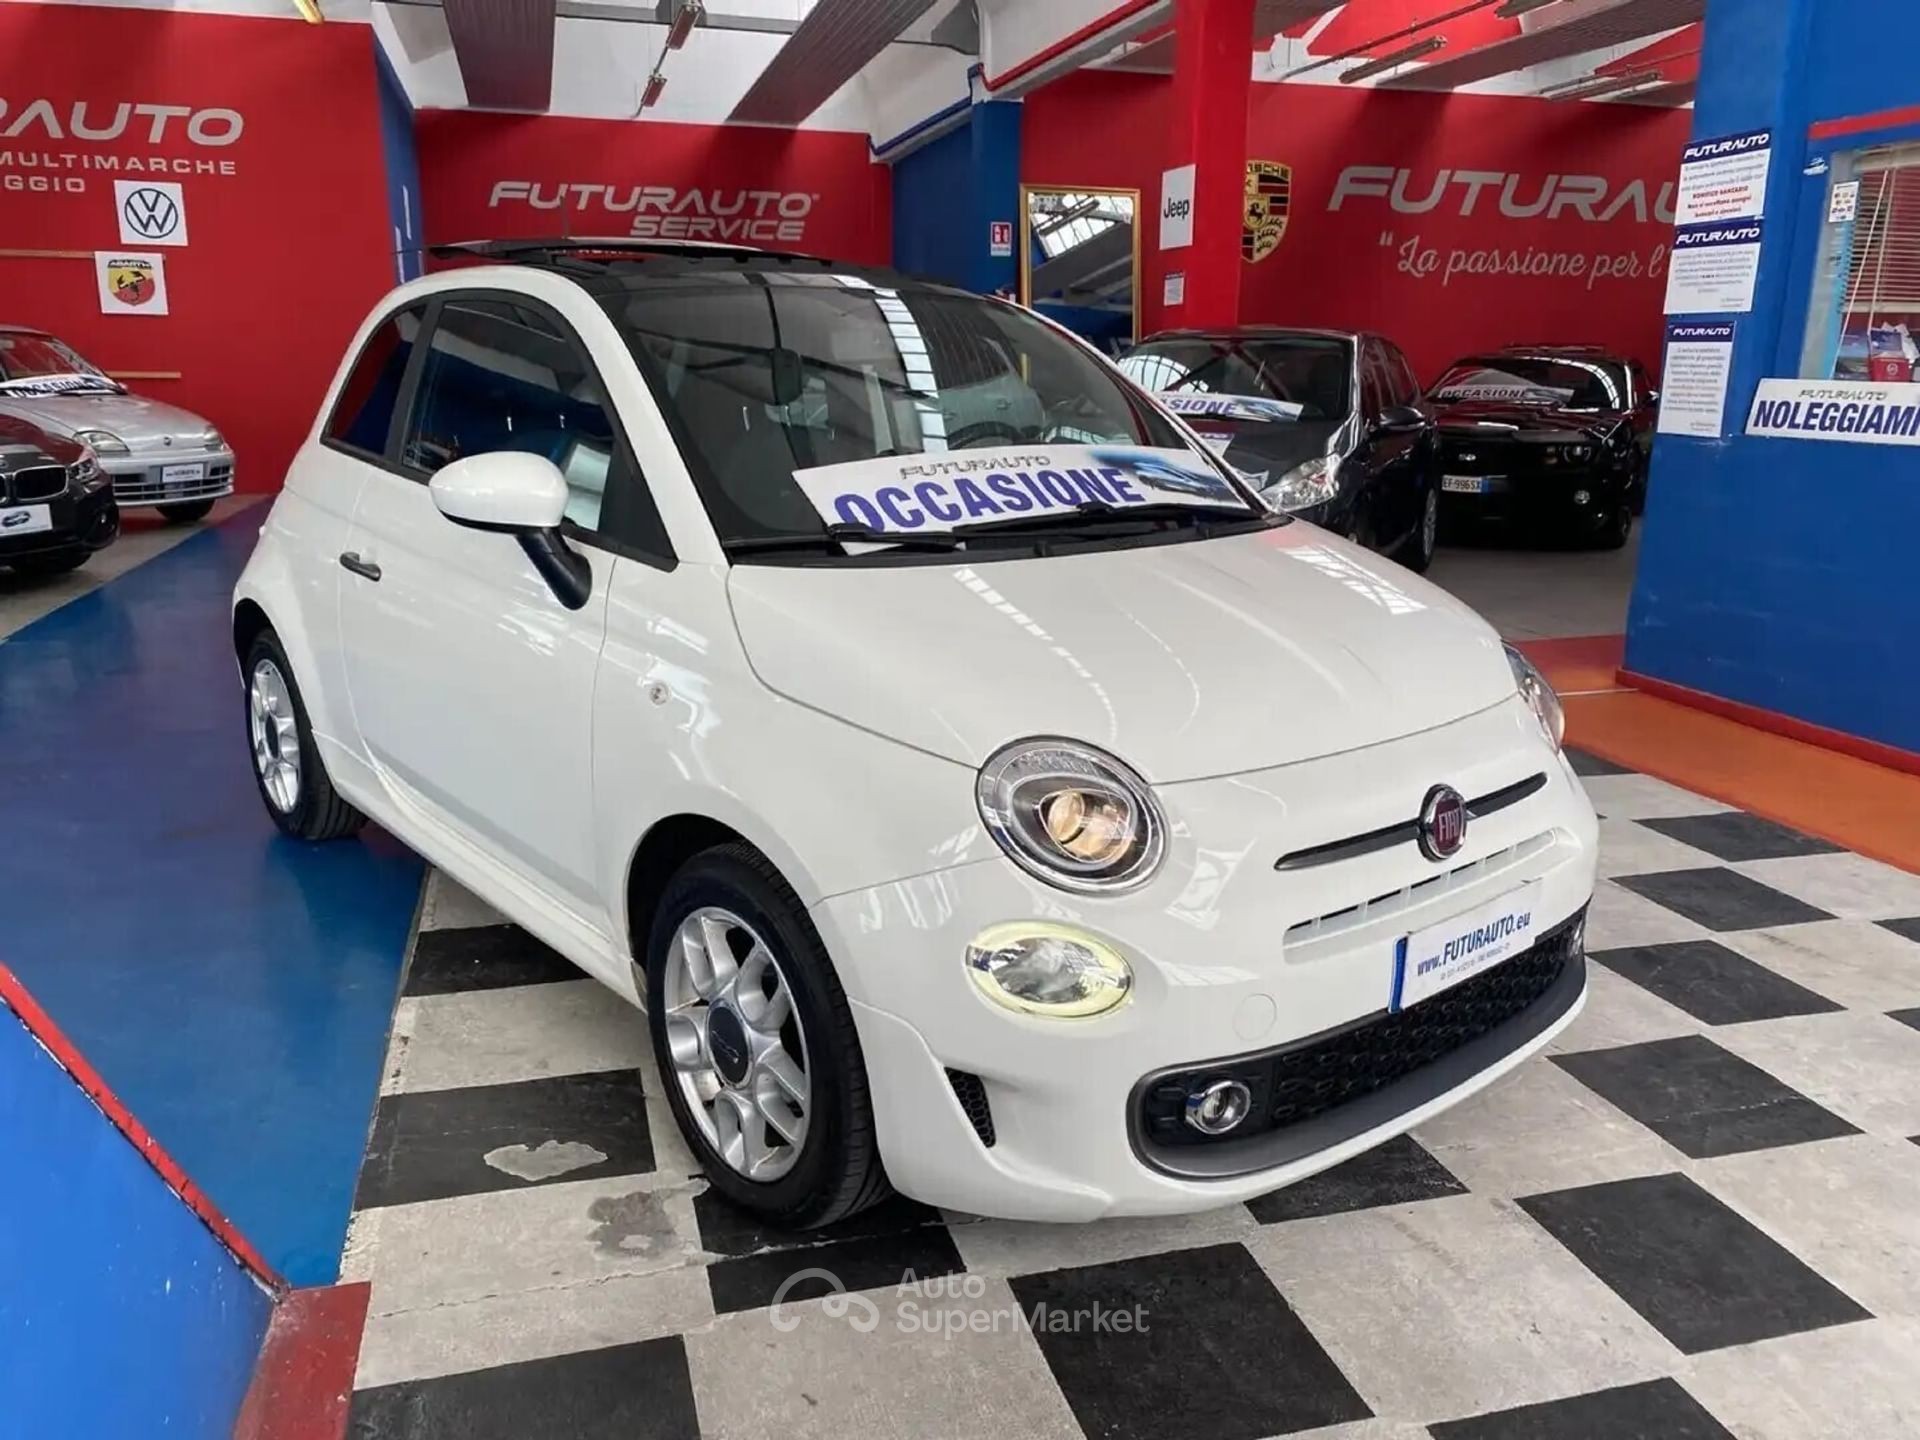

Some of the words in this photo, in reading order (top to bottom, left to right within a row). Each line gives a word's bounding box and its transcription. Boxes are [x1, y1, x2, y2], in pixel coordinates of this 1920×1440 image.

[0, 98, 244, 146] AUTO
[1683, 133, 1770, 160] FUTURAUTO
[1164, 198, 1190, 220] Jeep
[629, 215, 806, 241] SERVICE
[1675, 227, 1760, 245] FUTURAUTO
[1442, 247, 1587, 287] passione
[1586, 252, 1642, 291] per
[1673, 327, 1731, 336] FUTURAUTO
[1798, 388, 1888, 401] FUTURAUTO
[900, 455, 1052, 480] FUTURAUTO
[834, 467, 1144, 534] OCCASIONE
[1438, 808, 1461, 841] FIAT
[1417, 912, 1531, 976] www.FUTURAUTO.eu
